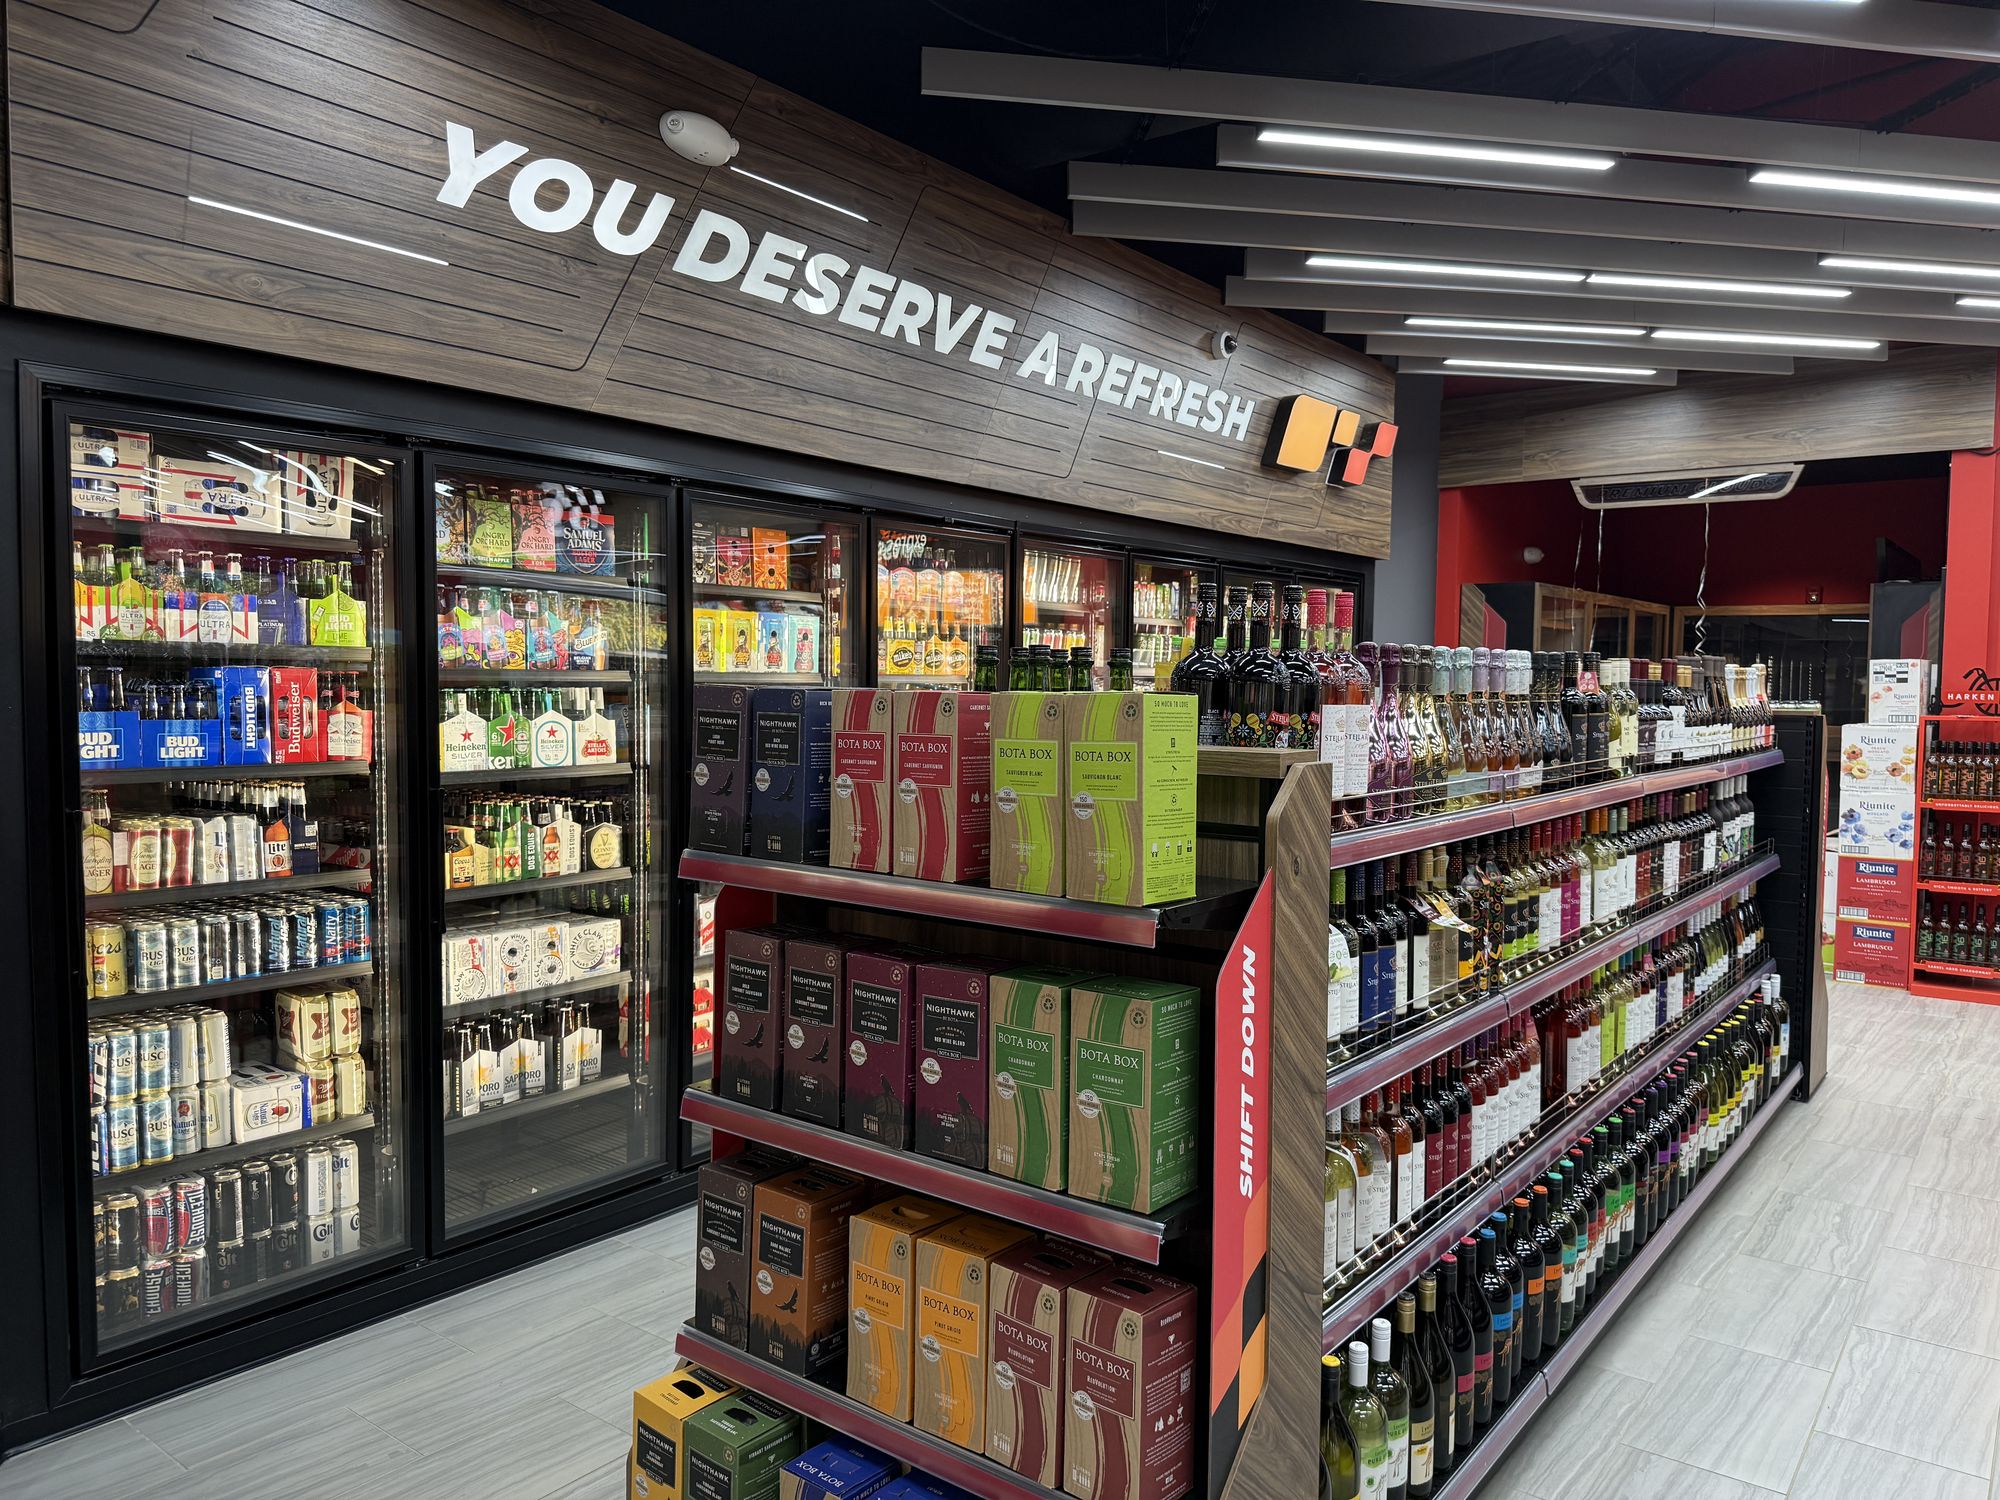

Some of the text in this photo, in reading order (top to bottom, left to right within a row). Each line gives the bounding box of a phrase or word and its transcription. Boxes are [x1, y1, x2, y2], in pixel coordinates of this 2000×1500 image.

[436, 121, 1256, 441] YOU DESERVE A REFRESH
[481, 531, 506, 540] ANGRY
[526, 536, 550, 544] ANGRY
[563, 528, 605, 542] SAMUEL
[475, 538, 510, 547] ORCHARD
[520, 542, 554, 551] ORCHARD
[568, 538, 602, 551] ADAMS
[574, 556, 596, 564] LAGER
[120, 612, 145, 620] ULTRA
[329, 615, 350, 623] BUD
[200, 620, 231, 629] ULTRA
[325, 622, 354, 631] LIGHT
[332, 632, 348, 640] LIME
[575, 636, 593, 650] BLUE
[1893, 692, 1918, 701] Riunite
[1948, 692, 1995, 701] HARKEN
[1154, 700, 1189, 709] SO MUCH TO LOVE
[244, 687, 256, 749] BUD LIGHT
[289, 682, 300, 754] Budweiser
[699, 715, 737, 726] NIGHTHAWK
[759, 719, 797, 729] NIGHTHAWK
[166, 736, 199, 748] BUD
[329, 736, 361, 744] Budweiser
[837, 738, 882, 750] BOTA BOX
[1860, 735, 1897, 746] Riunite
[160, 747, 205, 759] LIGHT
[446, 743, 487, 752] Heineken
[901, 742, 948, 754] BOTA BOX
[999, 747, 1053, 760] BOTA BOX
[451, 751, 483, 760] SILVER
[1075, 750, 1132, 763] BOTA BOX
[840, 758, 856, 766] CABERNET
[1006, 769, 1029, 777] SAUVIGNON
[1081, 773, 1106, 781] SAUVIGNON
[1859, 800, 1896, 811] Riunite
[268, 842, 287, 855] Lite
[527, 832, 536, 871] DOS EQUIS
[544, 851, 559, 861] XX
[1858, 862, 1895, 875] Riunite
[1855, 876, 1897, 886] LAMBRUSCO
[326, 915, 338, 945] Natty
[1855, 927, 1892, 940] Riunite
[269, 917, 281, 961] Natural
[296, 913, 308, 961] Natural
[570, 928, 603, 958] WHITE CLAW
[1853, 941, 1894, 951] LAMBRUSCO
[730, 963, 767, 977] NIGHTHAWK
[792, 975, 832, 989] NIGHTHAWK
[854, 989, 897, 1005] NIGHTHAWK
[926, 1003, 975, 1019] NIGHTHAWK
[942, 1037, 952, 1045] WINE
[952, 1039, 966, 1047] BLEND
[998, 1032, 1049, 1053] BOTA BOX
[938, 1049, 949, 1057] BOTA
[1080, 1047, 1139, 1070] BOTA BOX
[1007, 1056, 1036, 1067] CHARDONNAY
[504, 1069, 541, 1084] SAPPORO
[1239, 944, 1256, 1200] SHIFT DOWN
[1092, 1073, 1124, 1085] CHARDONNAY
[1084, 1094, 1094, 1102] 150
[260, 1102, 269, 1125] Natural
[704, 1199, 743, 1219] NIGHTHAWK
[188, 1189, 206, 1246] ICEHOUSE
[761, 1220, 802, 1241] NIGHTHAWK
[856, 1269, 901, 1296] BOTA BOX
[923, 1295, 975, 1322] BOTA BOX
[998, 1321, 1048, 1353] BOTA BOX
[1075, 1348, 1131, 1381] BOTA BOX
[639, 1426, 674, 1454] NIGHTHAWK
[691, 1455, 729, 1484] NIGHTHAWK
[796, 1460, 844, 1488] BOTA BOX
